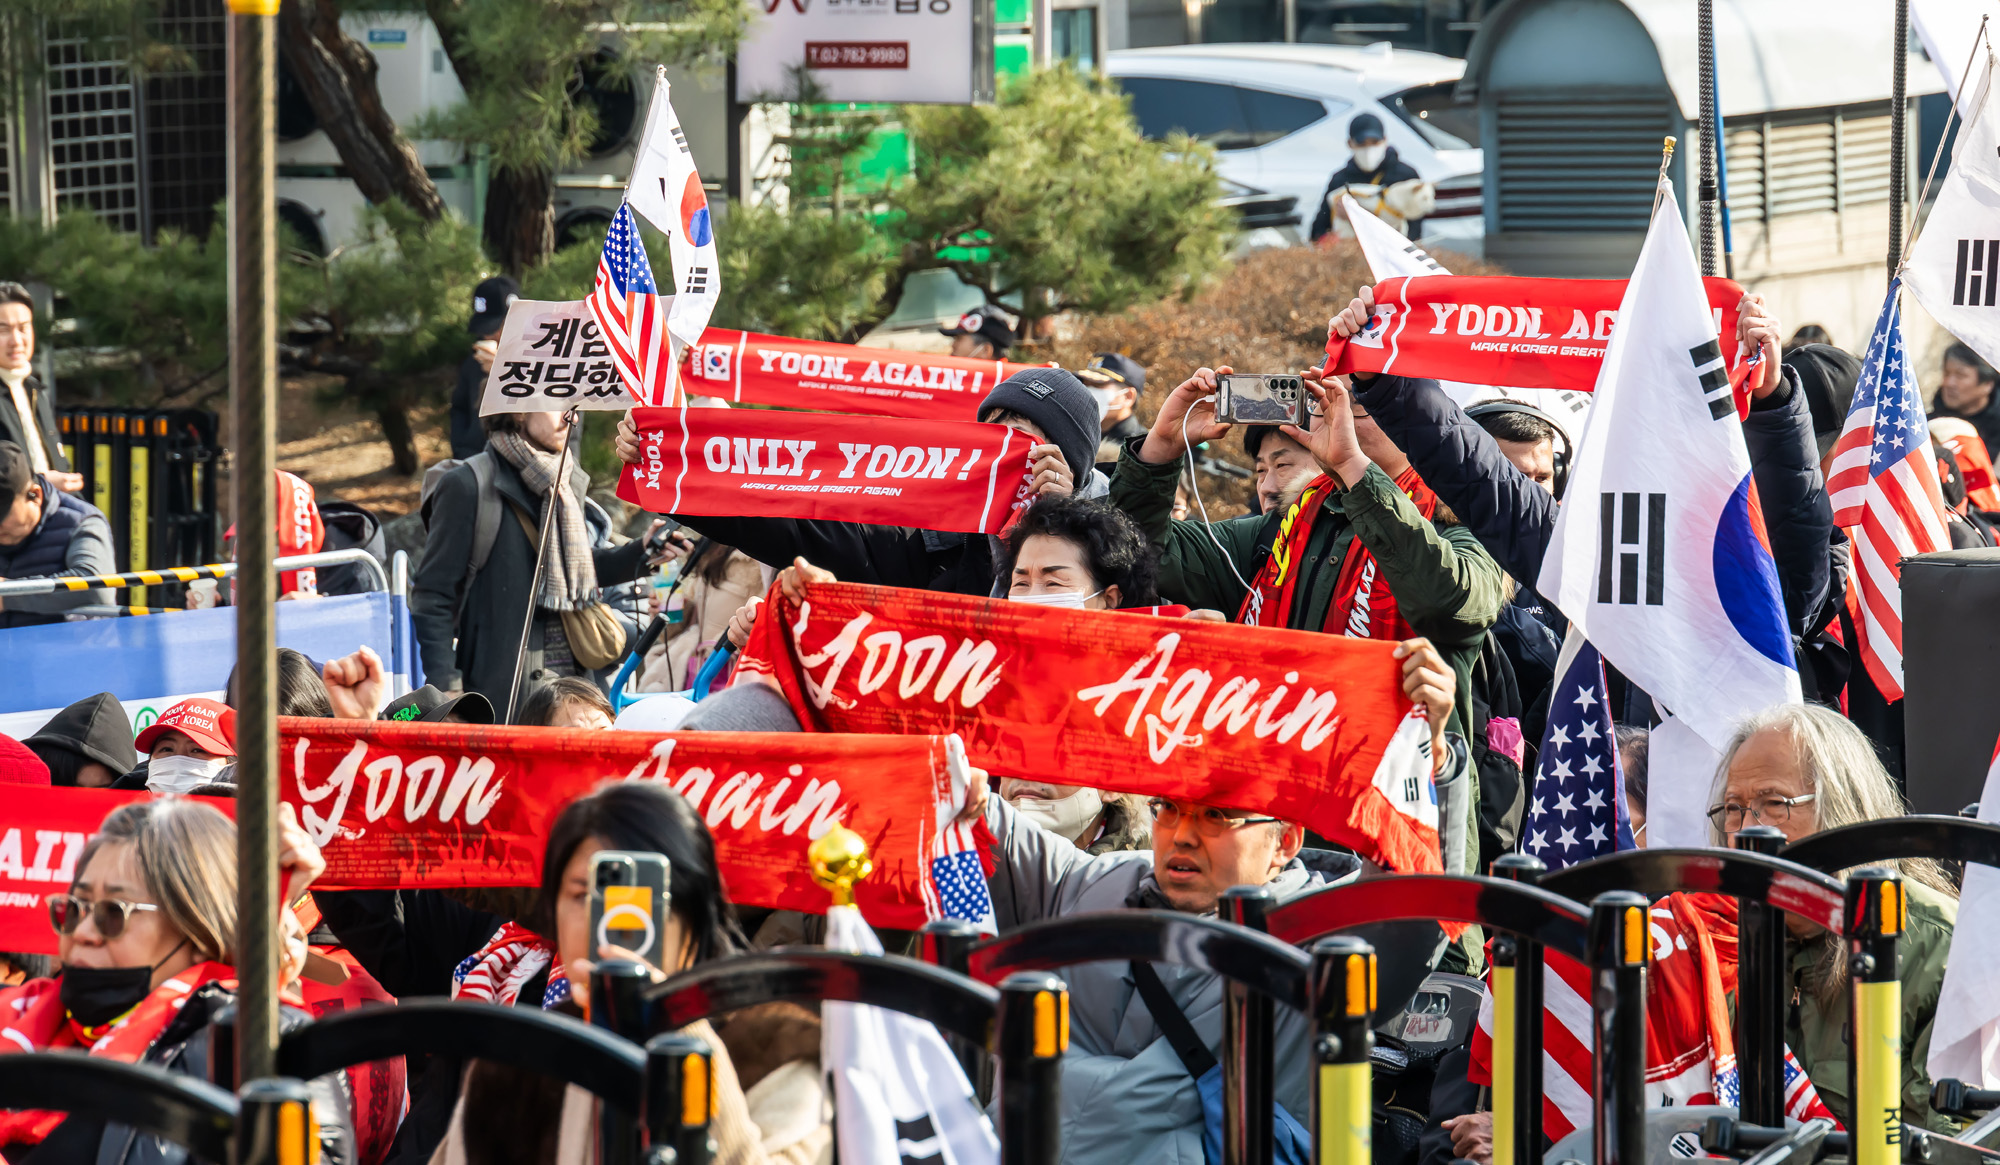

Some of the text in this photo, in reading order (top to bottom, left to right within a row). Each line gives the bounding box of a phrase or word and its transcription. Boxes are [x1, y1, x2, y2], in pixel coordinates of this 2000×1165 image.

[1426, 302, 1552, 340] YOON,
[757, 348, 854, 383] YOON,
[1470, 341, 1510, 352] MAKE
[1510, 343, 1558, 355] KOREA
[797, 380, 934, 401] MAKE KOREA GREAT AGAIN
[645, 429, 664, 491] YOON
[703, 436, 983, 481] ONLY, YOON!
[740, 482, 903, 497] MAKE KOREA GREAT AGAIN
[792, 600, 1015, 710] Yoon
[1076, 631, 1340, 764] Again
[182, 714, 214, 732] KOREA
[186, 704, 218, 720] AGAIN
[294, 736, 511, 849] Yoon
